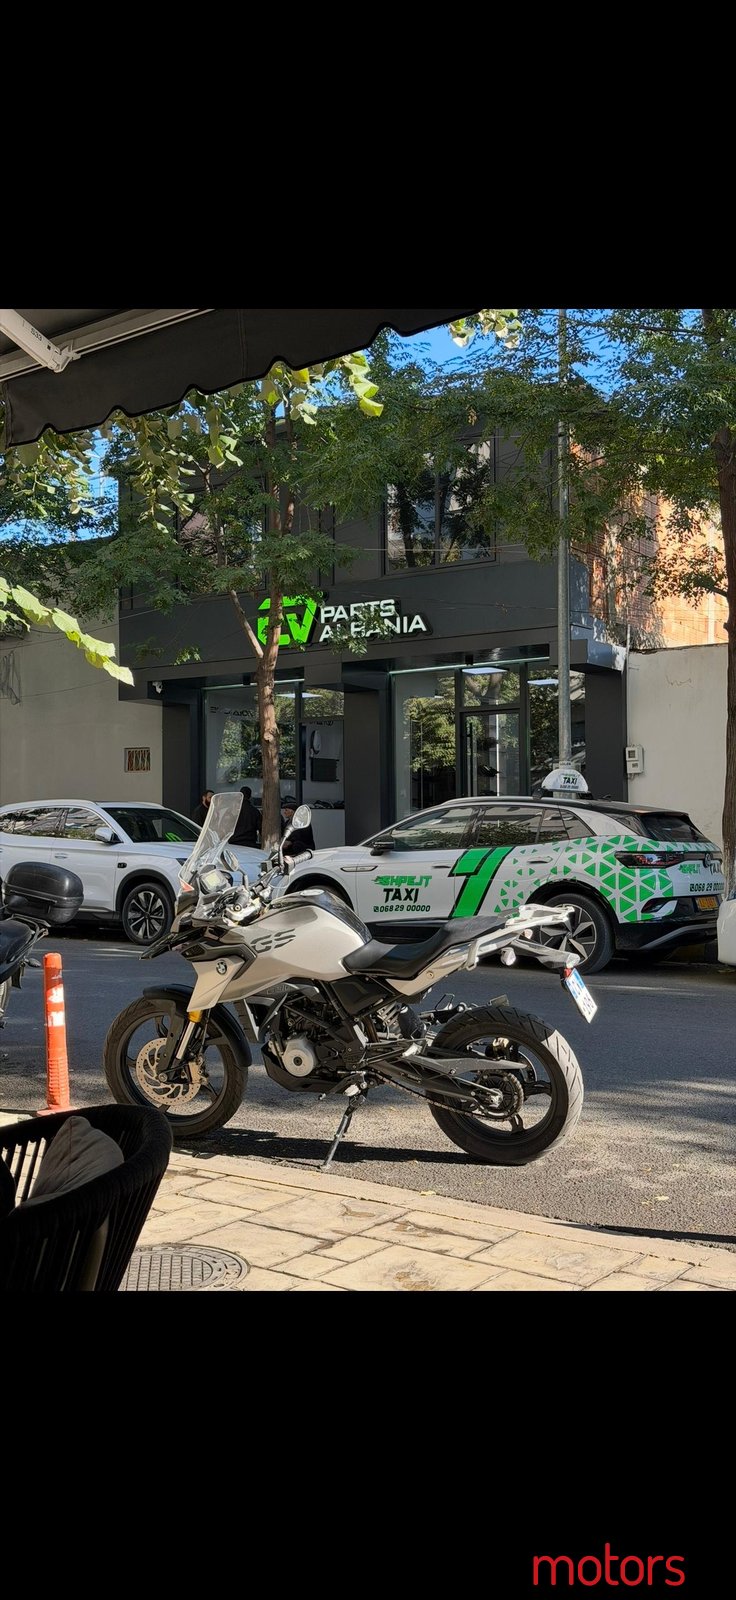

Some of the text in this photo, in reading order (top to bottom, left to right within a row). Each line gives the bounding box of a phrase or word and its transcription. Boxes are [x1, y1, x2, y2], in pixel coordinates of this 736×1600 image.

[320, 598, 396, 624] PARTS
[318, 614, 427, 643] ABANIA
[562, 776, 578, 786] TAXI
[377, 875, 433, 888] SHPEJT
[383, 888, 420, 904] TAXI
[379, 904, 431, 913] 068 29 00000
[250, 928, 296, 954] GS
